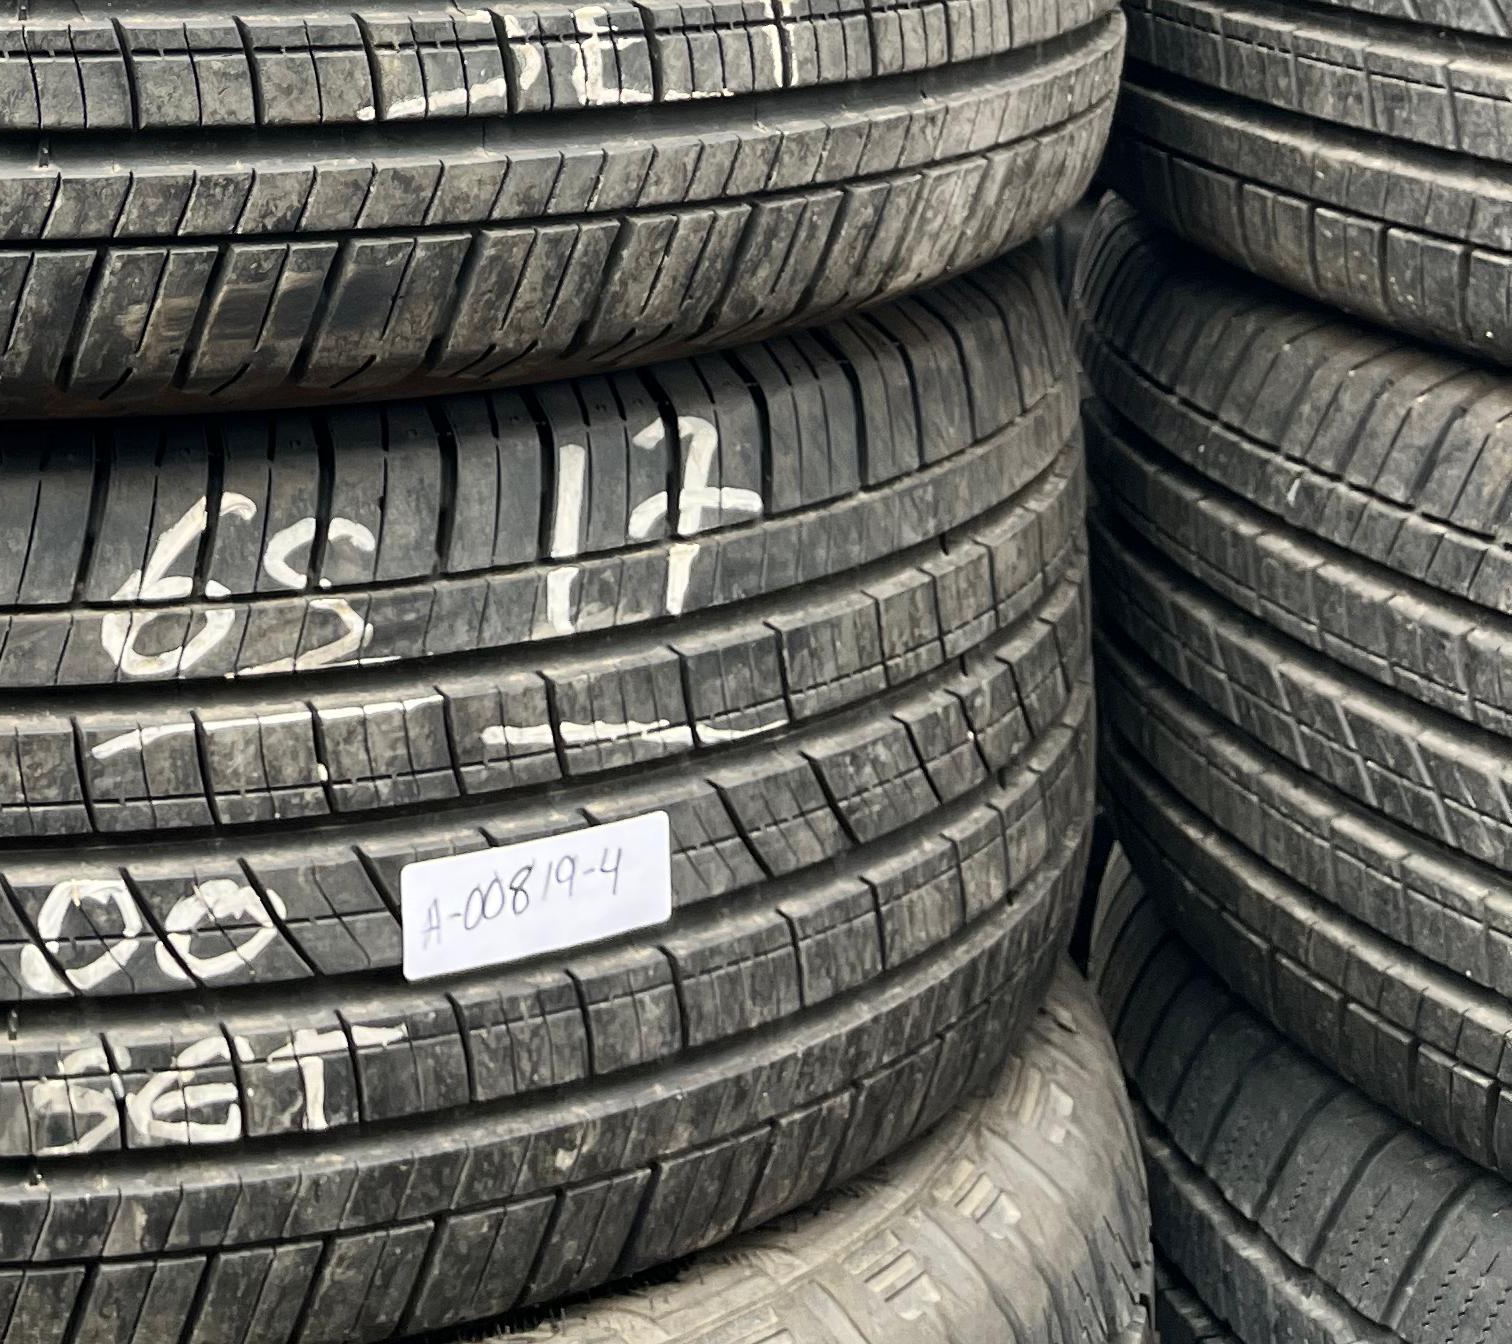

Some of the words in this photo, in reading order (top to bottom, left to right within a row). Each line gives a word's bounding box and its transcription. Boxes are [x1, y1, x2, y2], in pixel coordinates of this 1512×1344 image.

[101, 490, 396, 680] 65
[543, 414, 763, 634] 17
[422, 847, 622, 950] A-00819-4
